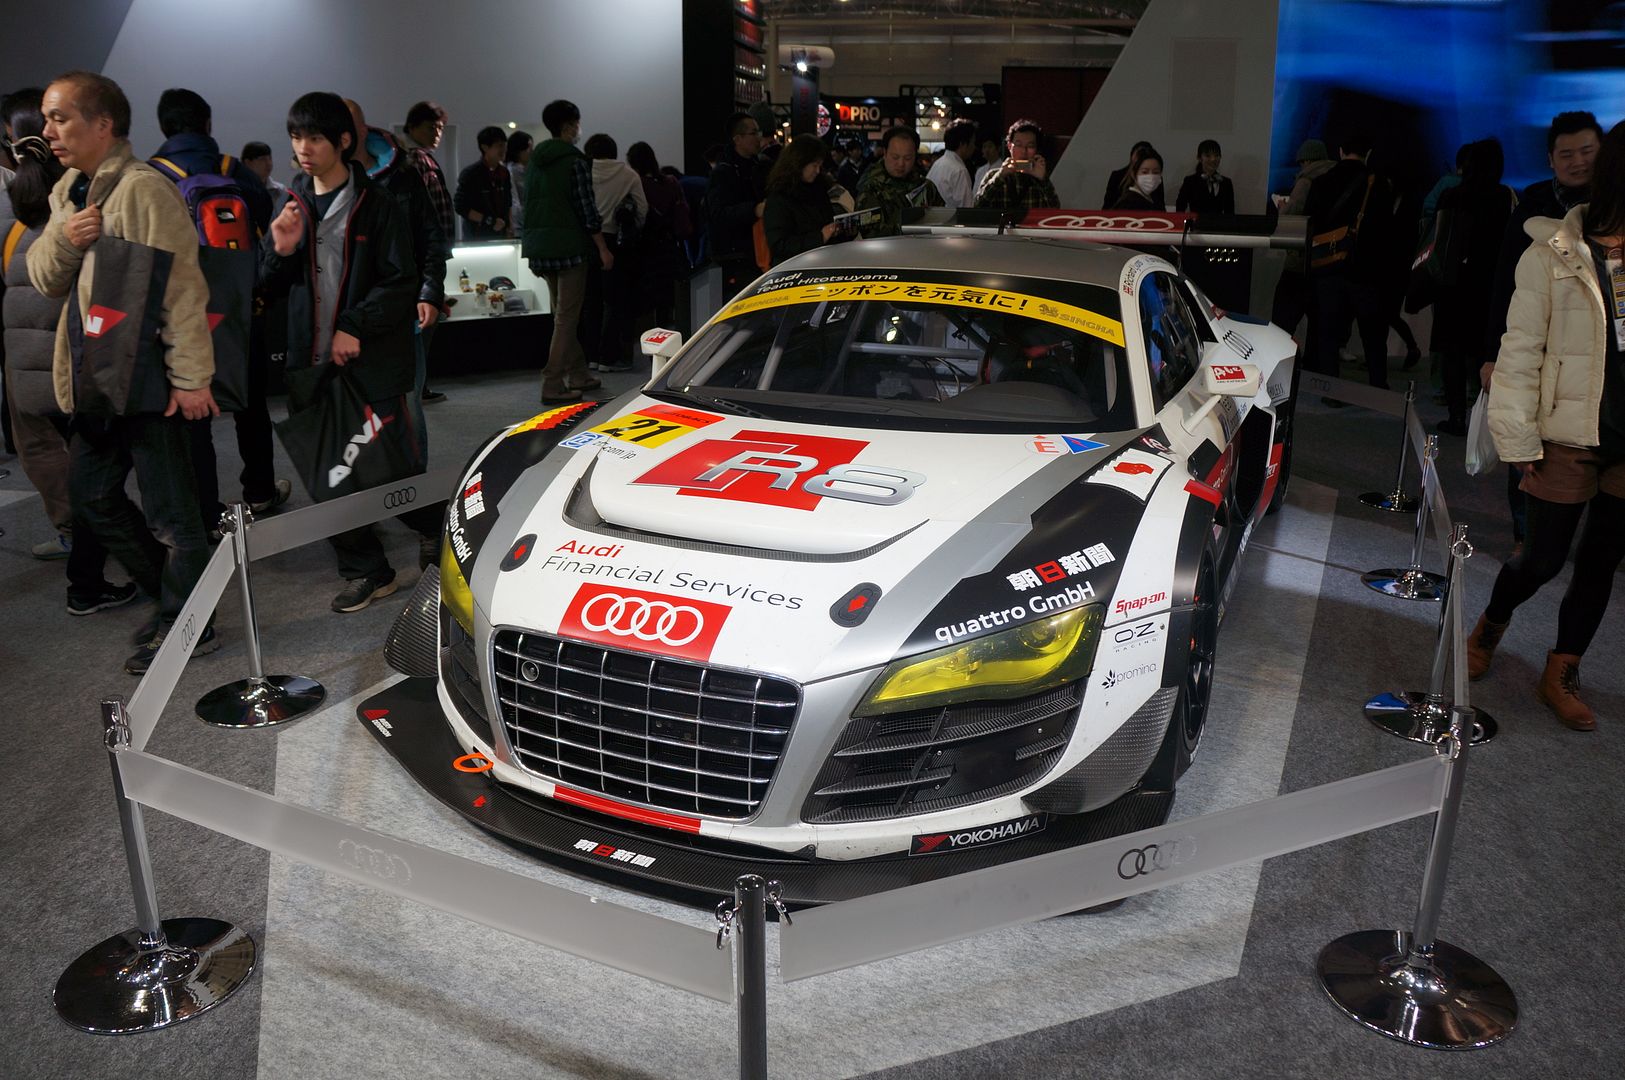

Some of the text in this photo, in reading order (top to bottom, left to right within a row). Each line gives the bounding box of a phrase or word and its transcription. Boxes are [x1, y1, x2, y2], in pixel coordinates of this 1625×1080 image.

[756, 274, 898, 294] Team Hitotsuyama
[762, 272, 803, 286] Audi
[1059, 313, 1116, 337] SINGHA
[601, 419, 682, 442] 21
[693, 450, 927, 506] R8
[556, 540, 624, 558] Audi
[1006, 542, 1116, 592] 朝日新聞
[541, 555, 804, 610] Financial Services
[935, 581, 1096, 644] quattro GmbH
[949, 816, 1040, 847] YOKOHAMA
